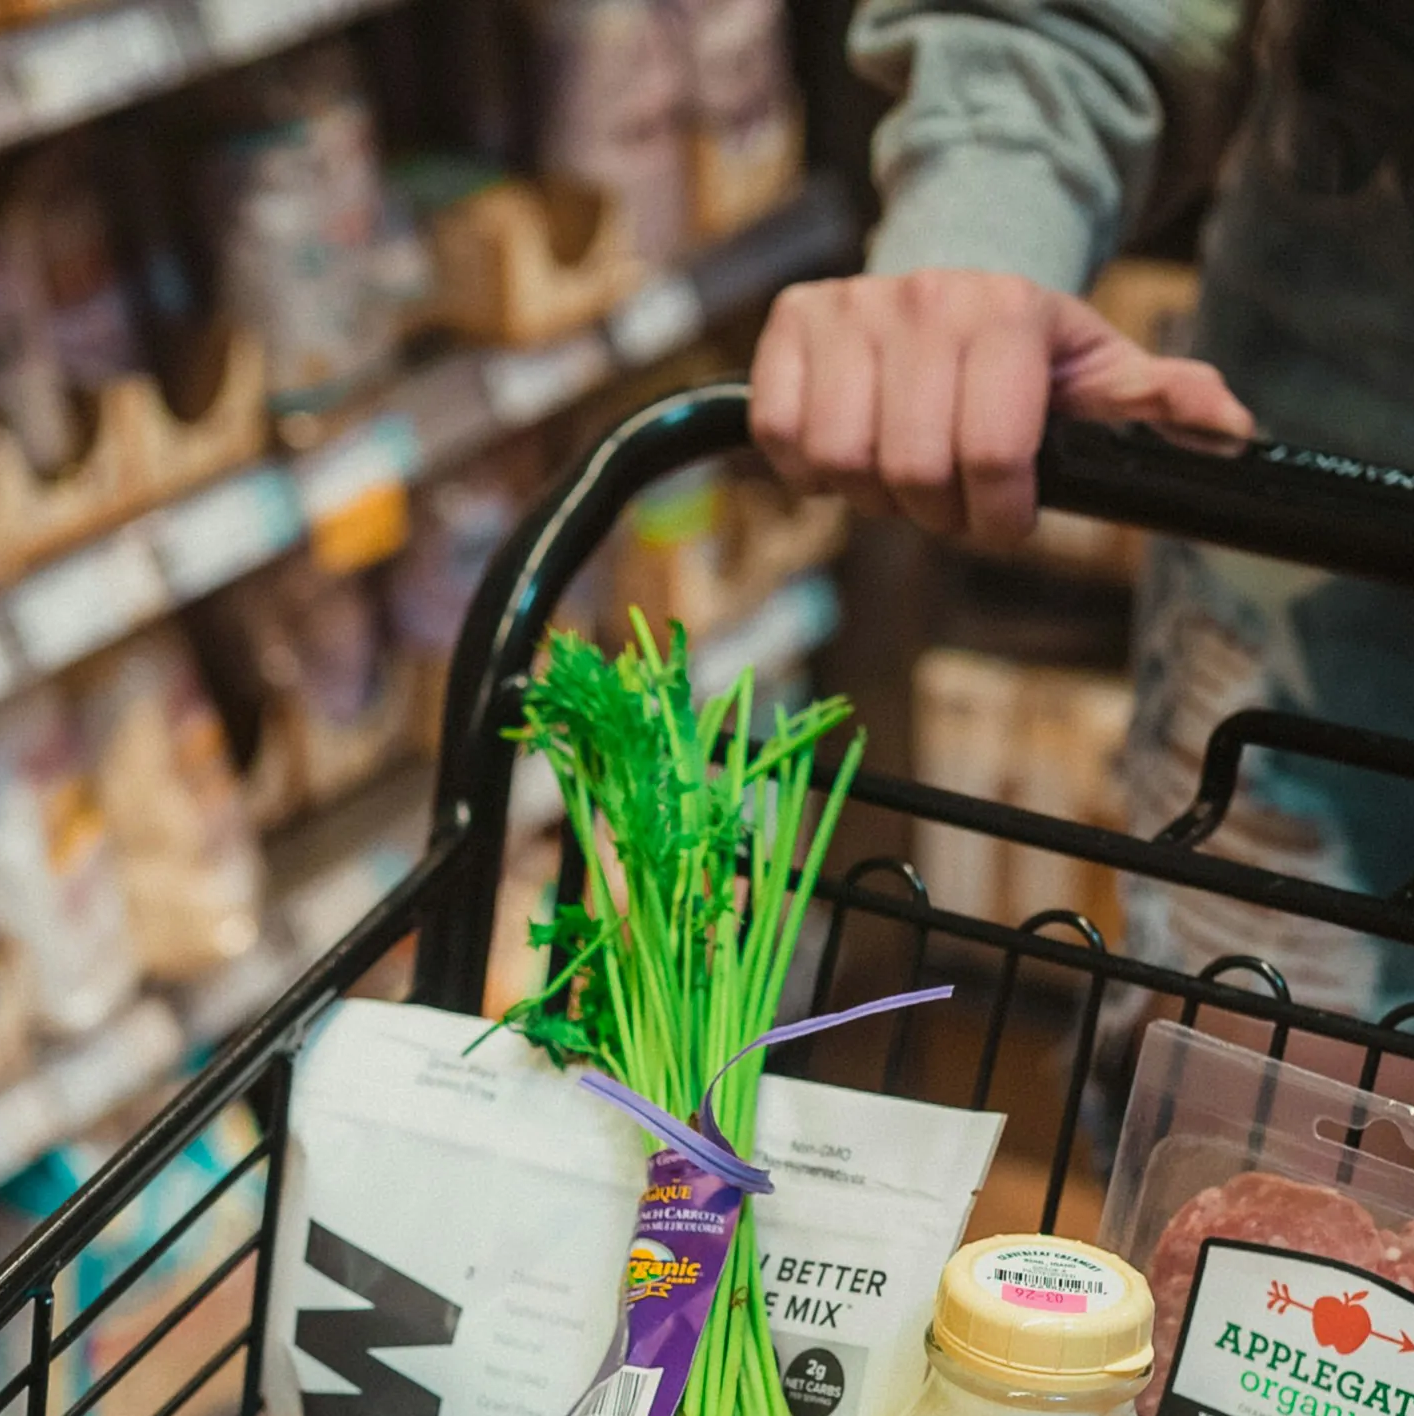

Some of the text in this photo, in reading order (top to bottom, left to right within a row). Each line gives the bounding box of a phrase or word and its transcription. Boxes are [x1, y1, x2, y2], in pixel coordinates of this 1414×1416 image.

[627, 1256, 702, 1279] rganic
[776, 1256, 888, 1298] BETTER
[1014, 1287, 1064, 1304] 03-26
[805, 1359, 828, 1381] 2g
[805, 1380, 843, 1400] CARBS
